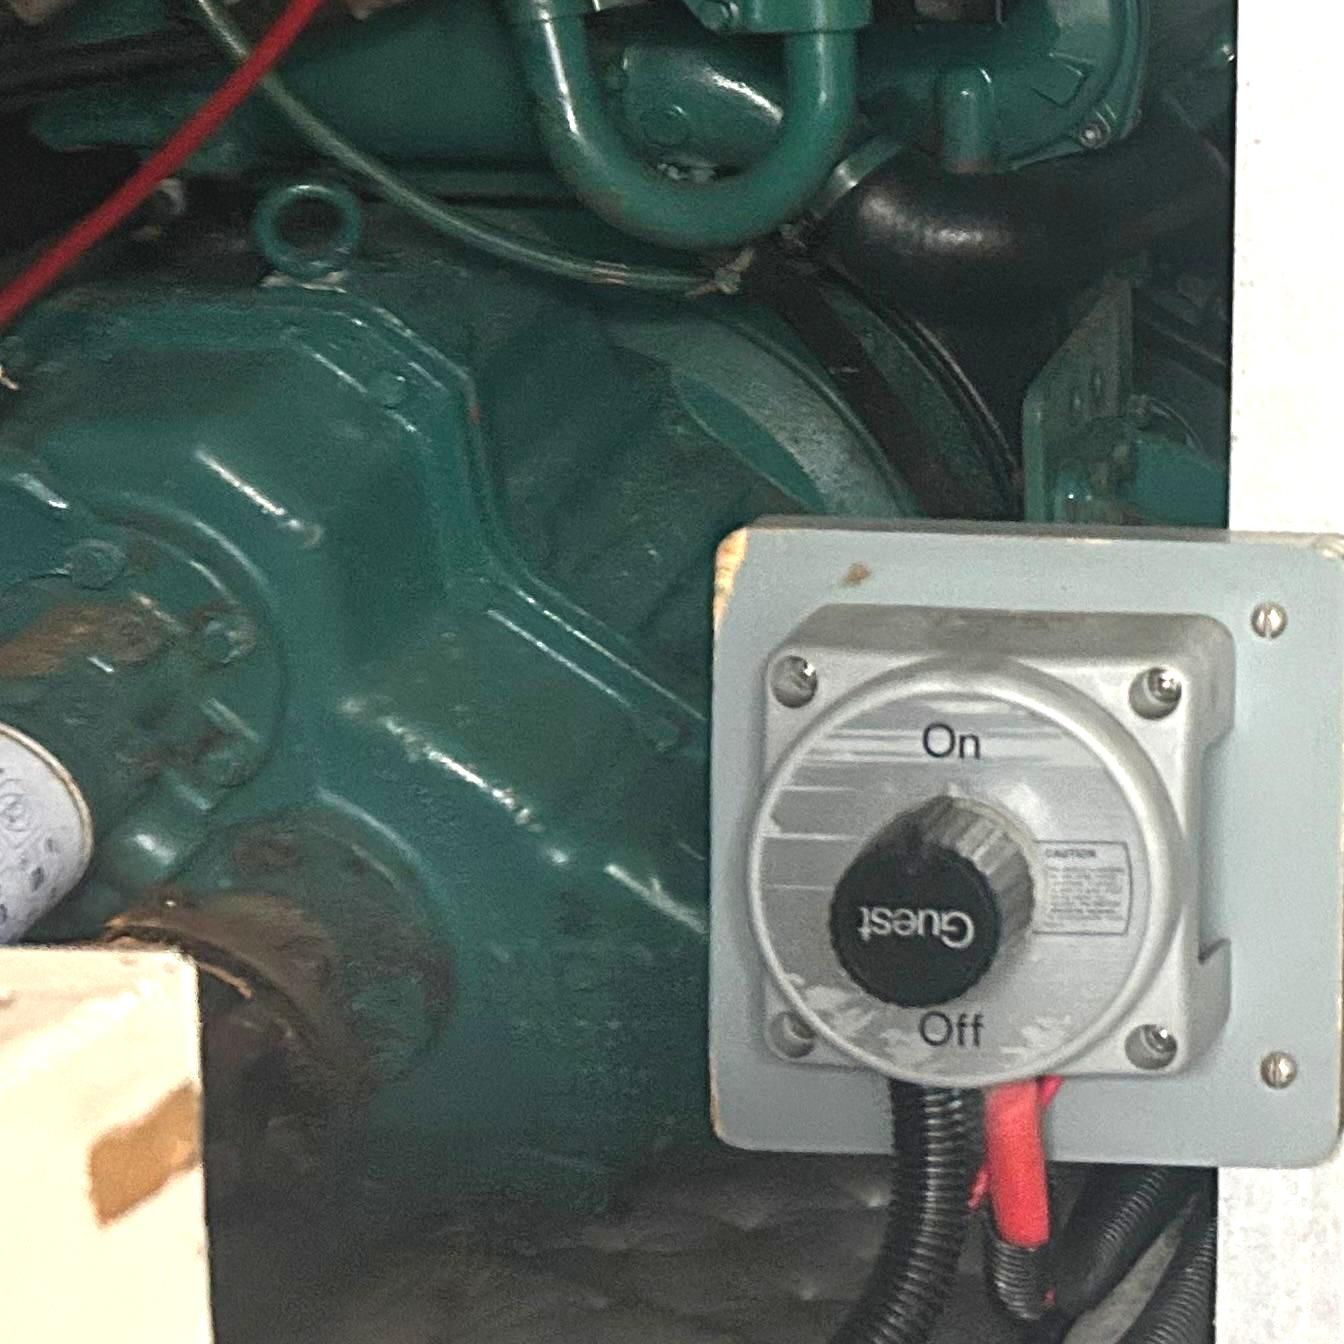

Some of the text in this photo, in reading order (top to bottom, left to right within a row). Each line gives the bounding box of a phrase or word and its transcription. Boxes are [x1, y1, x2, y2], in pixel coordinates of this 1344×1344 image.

[923, 722, 981, 760] On
[857, 906, 975, 949] Guest
[919, 1011, 985, 1048] Off
